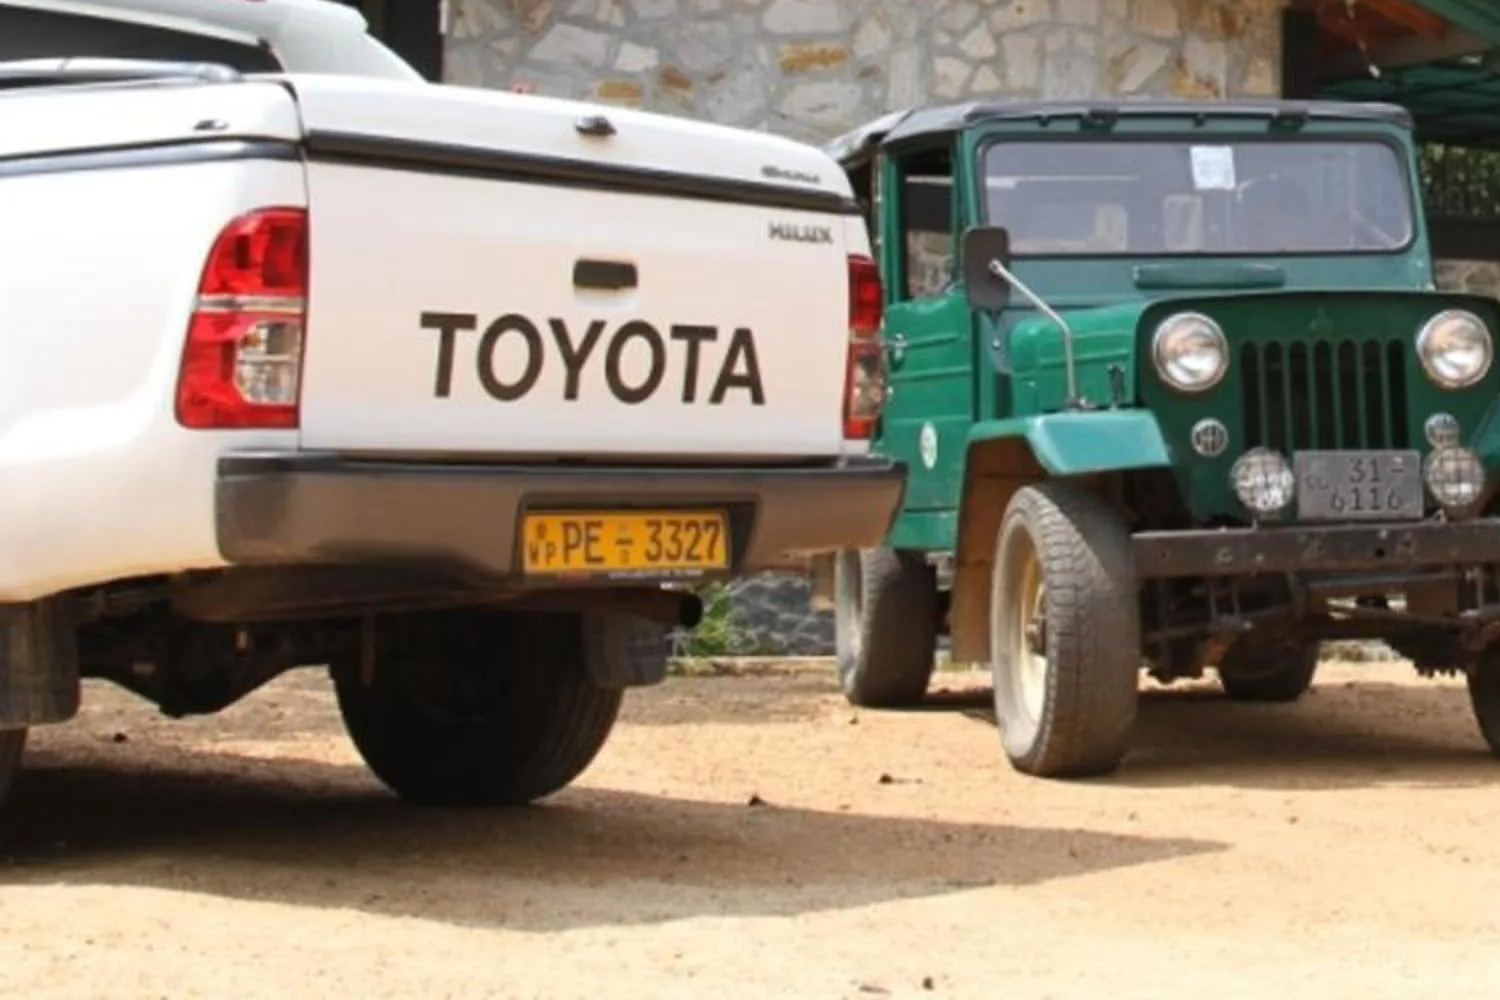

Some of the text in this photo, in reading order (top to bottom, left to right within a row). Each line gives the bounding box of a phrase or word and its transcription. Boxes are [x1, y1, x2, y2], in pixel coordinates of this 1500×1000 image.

[768, 221, 833, 244] HILUX
[420, 312, 766, 405] TOYOTA
[1330, 485, 1403, 512] 6116
